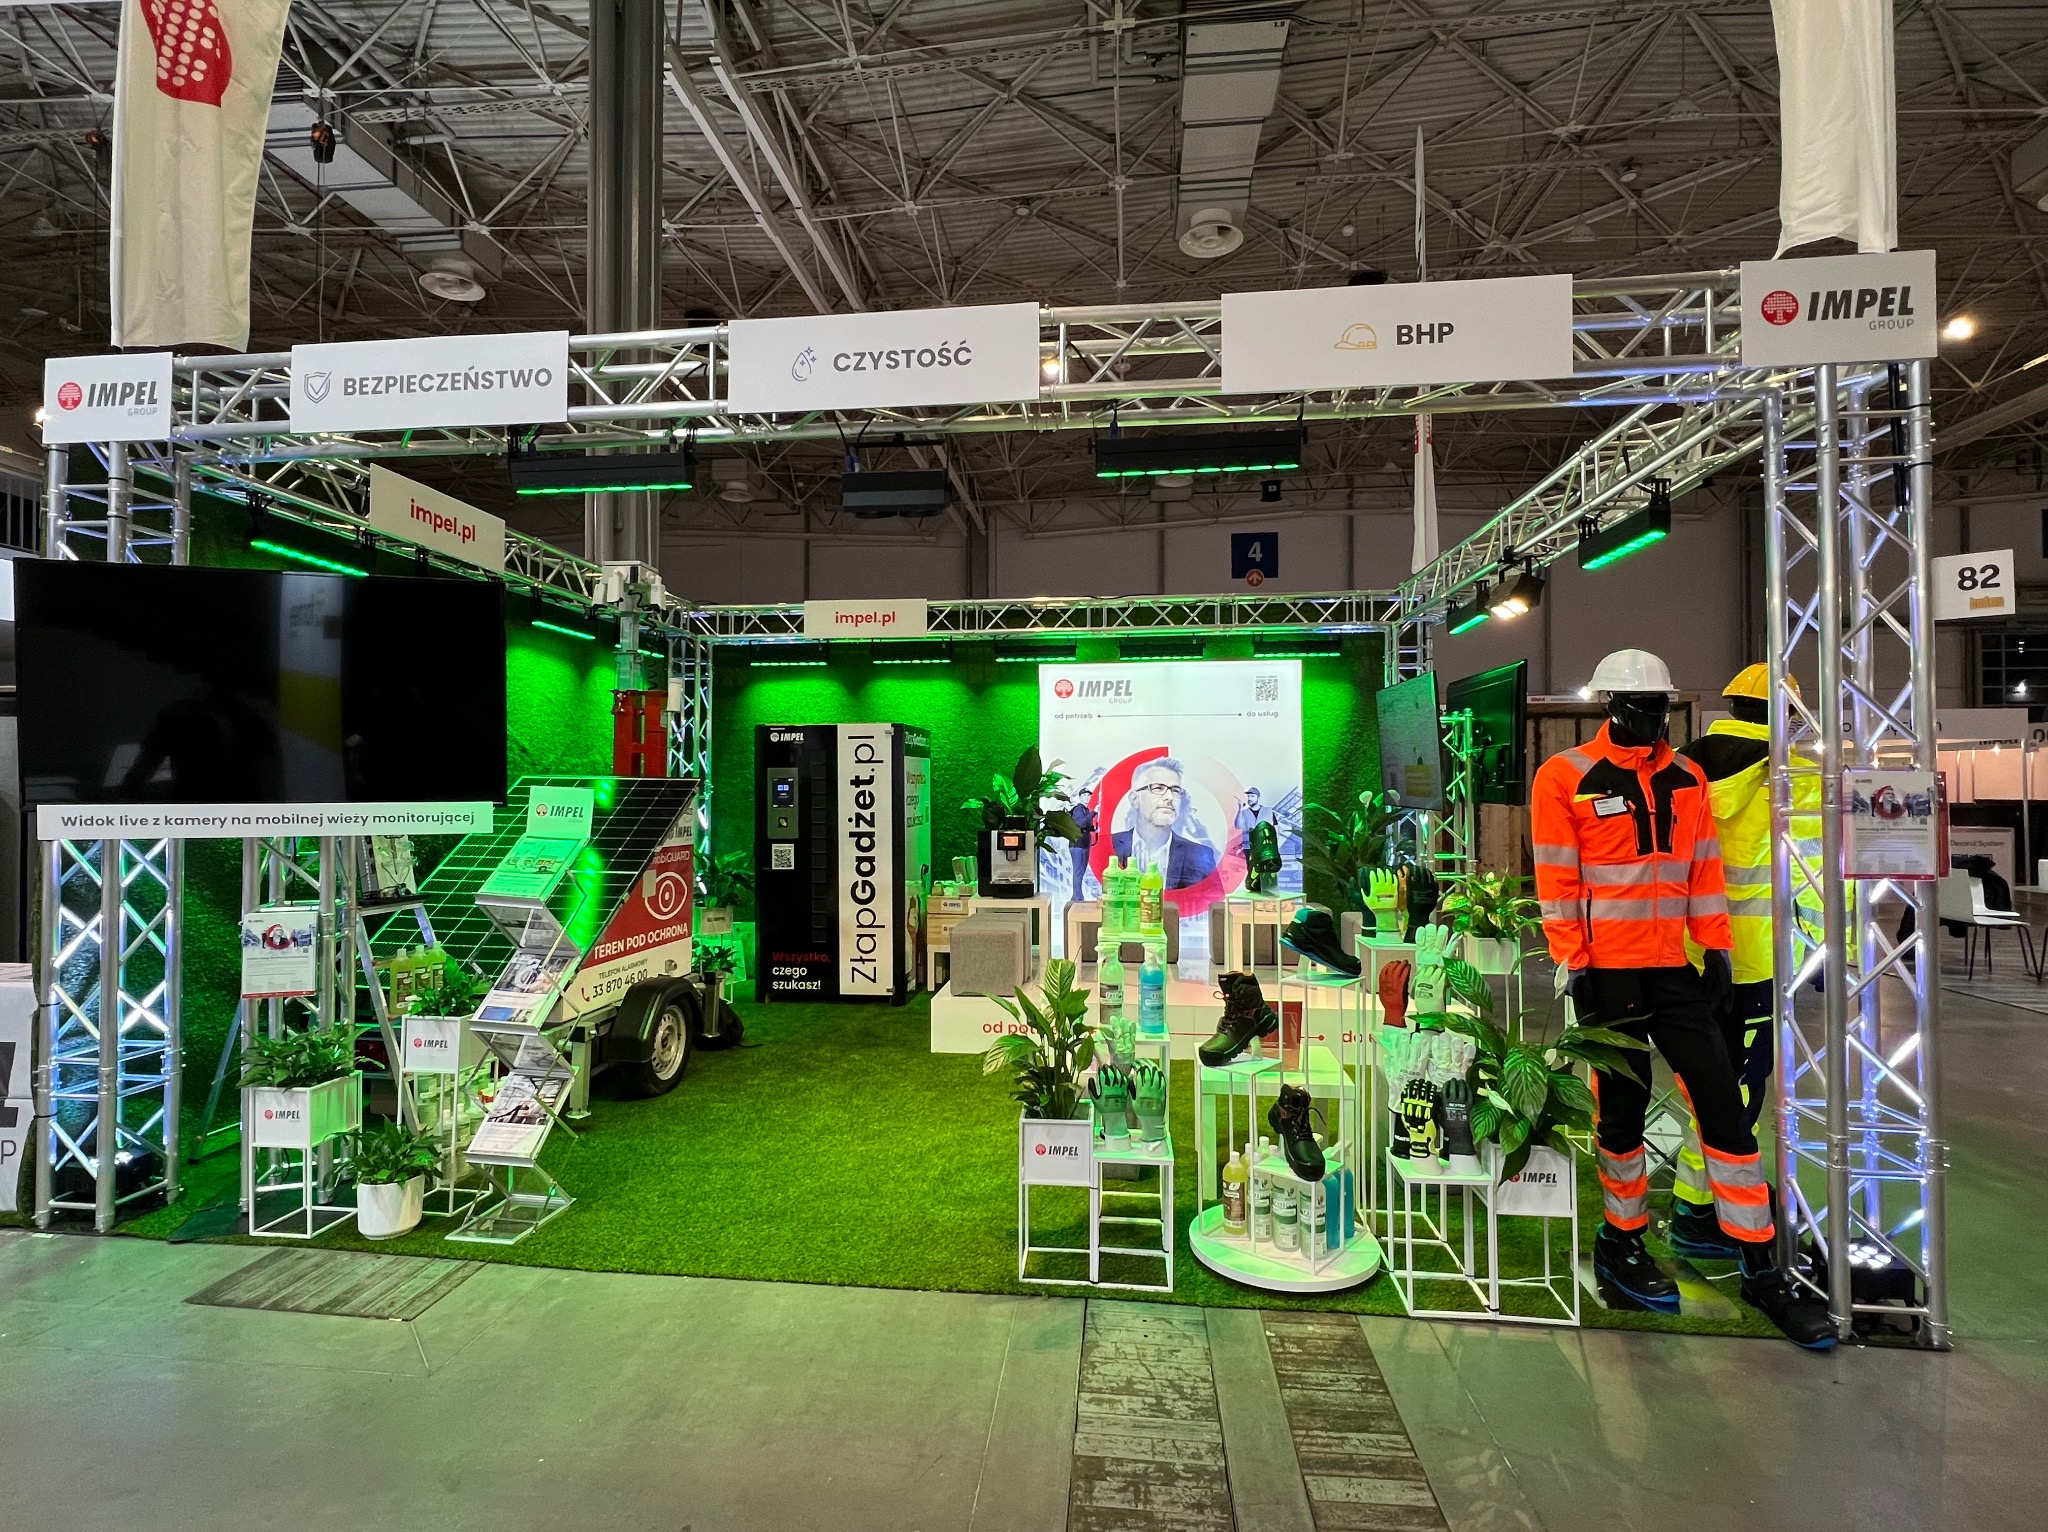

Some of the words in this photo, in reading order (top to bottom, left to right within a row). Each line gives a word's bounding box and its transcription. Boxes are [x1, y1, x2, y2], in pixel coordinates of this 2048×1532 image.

[1807, 285, 1915, 321] IMPEL
[1869, 318, 1915, 331] GROUP
[1396, 322, 1455, 346] BHP
[833, 339, 973, 373] CZYSTOŚĆ
[343, 365, 553, 397] BEZPIECZEŃSTWO
[87, 381, 159, 408] IMPEL
[127, 407, 159, 417] GROUP
[410, 497, 477, 544] impel.pl
[1247, 541, 1263, 562] 4
[1957, 563, 2001, 592] 82
[835, 611, 896, 627] impel.pl
[1077, 679, 1133, 698] IMPEL
[1108, 697, 1133, 705] GROUP
[1054, 712, 1065, 721] od
[1065, 712, 1094, 722] potrzeb
[1246, 709, 1257, 718] do
[780, 732, 804, 742] IMPEL
[550, 805, 584, 818] IMPEL
[61, 814, 115, 827] Widok
[119, 814, 149, 826] live
[152, 817, 161, 826] z
[164, 815, 228, 829] kamery
[231, 816, 251, 825] na
[255, 813, 324, 827] mobilnej
[327, 812, 369, 827] wieży
[372, 811, 475, 826] monitorującej
[847, 735, 886, 984] ZłapGadżet.pl
[594, 940, 625, 960] TEREN
[626, 933, 646, 951] POD
[649, 922, 688, 945] OCHRONĄ
[772, 951, 831, 965] Wszystko,
[598, 967, 621, 980] TELEFON
[772, 966, 808, 978] czego
[592, 984, 604, 999] 33
[605, 977, 622, 994] 870
[624, 972, 636, 987] 46
[637, 968, 648, 981] 00
[772, 979, 821, 990] szukasz!
[982, 1020, 1003, 1034] od
[423, 1039, 448, 1049] IMPEL
[275, 1109, 300, 1120] IMPEL
[1048, 1145, 1079, 1157] IMPEL
[1522, 1171, 1558, 1184] IMPEL
